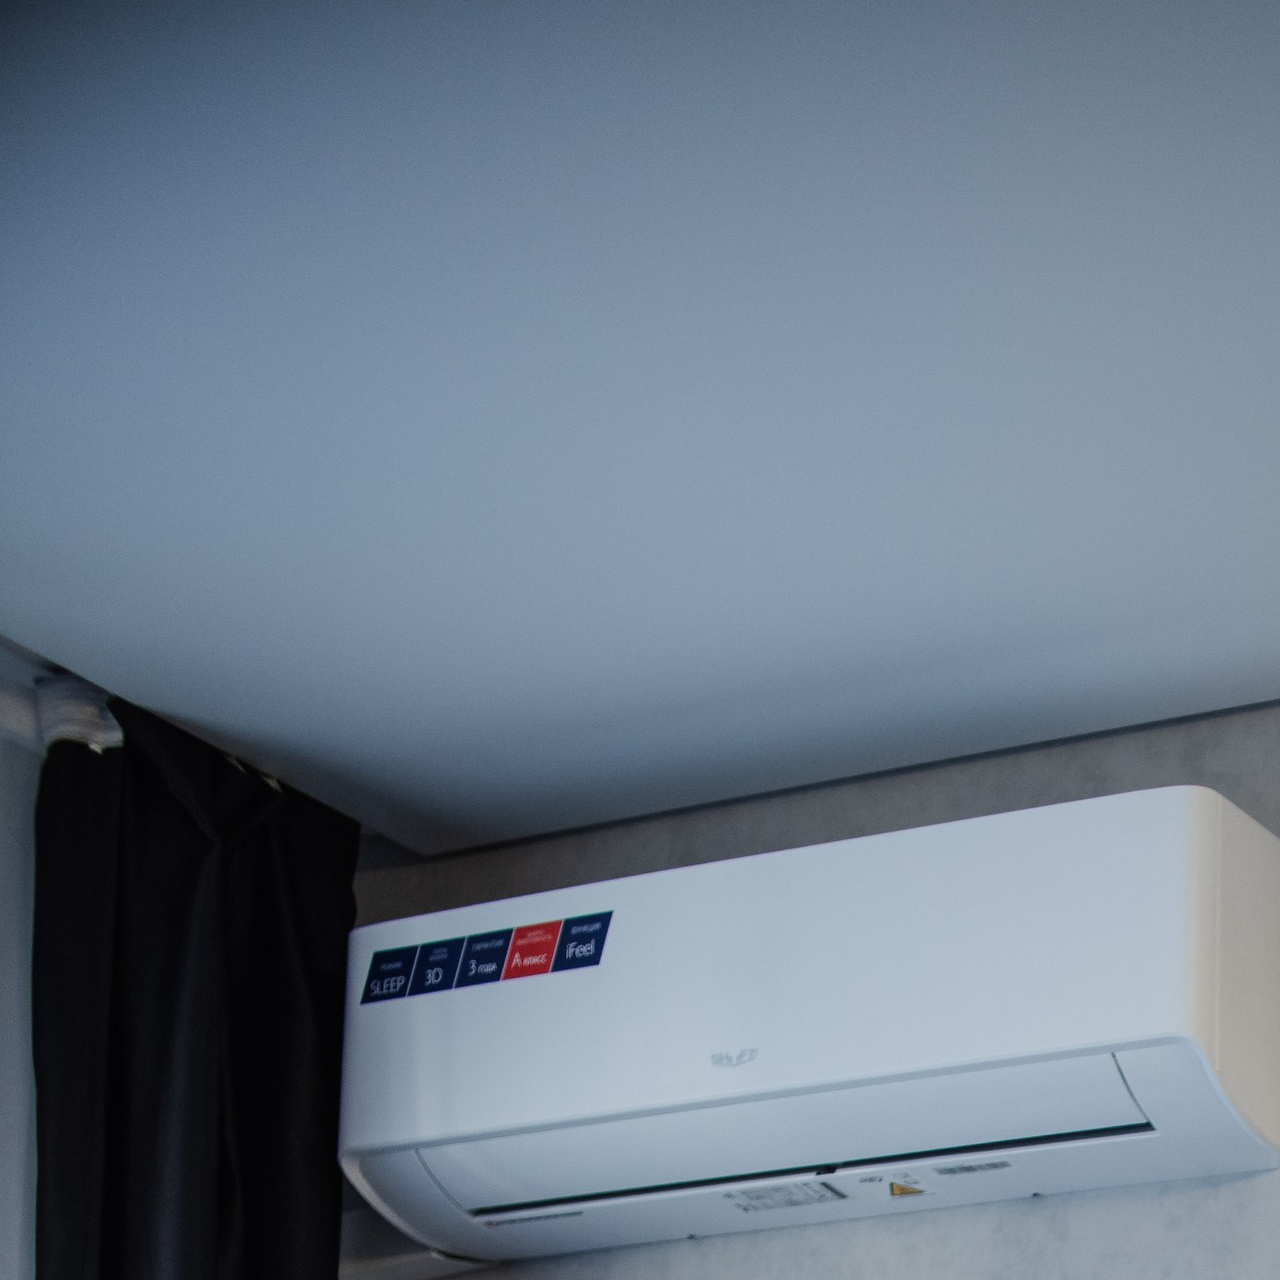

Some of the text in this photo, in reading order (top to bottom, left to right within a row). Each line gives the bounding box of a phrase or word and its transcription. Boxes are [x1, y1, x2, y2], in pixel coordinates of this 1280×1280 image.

[566, 939, 595, 960] iFeel
[424, 967, 444, 986] 3D
[468, 959, 478, 977] 3
[370, 976, 405, 997] SLEEP
